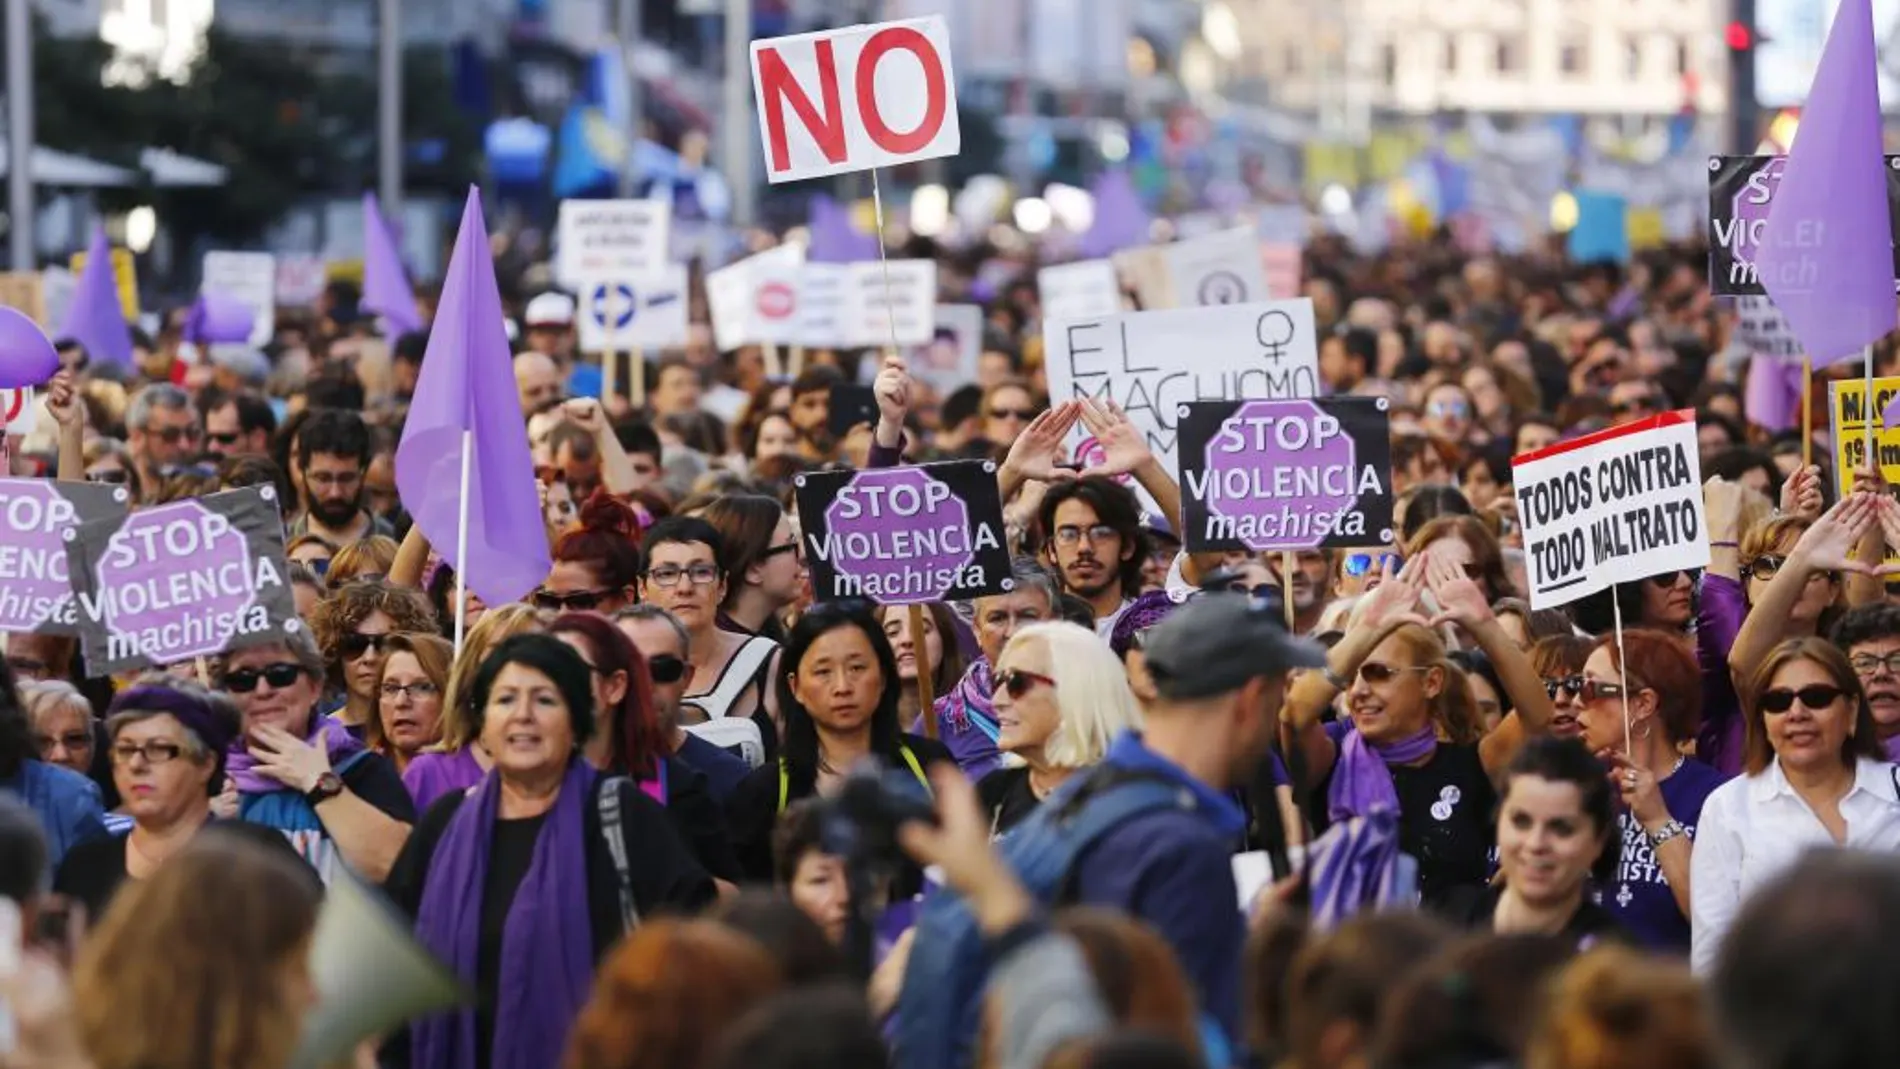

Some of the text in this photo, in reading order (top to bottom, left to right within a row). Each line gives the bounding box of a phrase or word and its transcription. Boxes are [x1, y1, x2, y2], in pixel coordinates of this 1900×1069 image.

[757, 27, 946, 172] NO
[1067, 322, 1159, 377] EL
[1221, 415, 1341, 452] STOP
[837, 480, 950, 519] STOP
[1185, 464, 1384, 500] VIOLENCIA
[1519, 443, 1691, 529] TODOS CONTRA
[109, 513, 229, 568] STOP
[808, 521, 999, 561] VIOLENCIA
[1205, 504, 1366, 540] machista
[1531, 498, 1698, 584] TODO MALTRATO
[79, 556, 282, 622] VIOLENCIA
[834, 563, 986, 596] machista
[107, 604, 271, 660] machista
